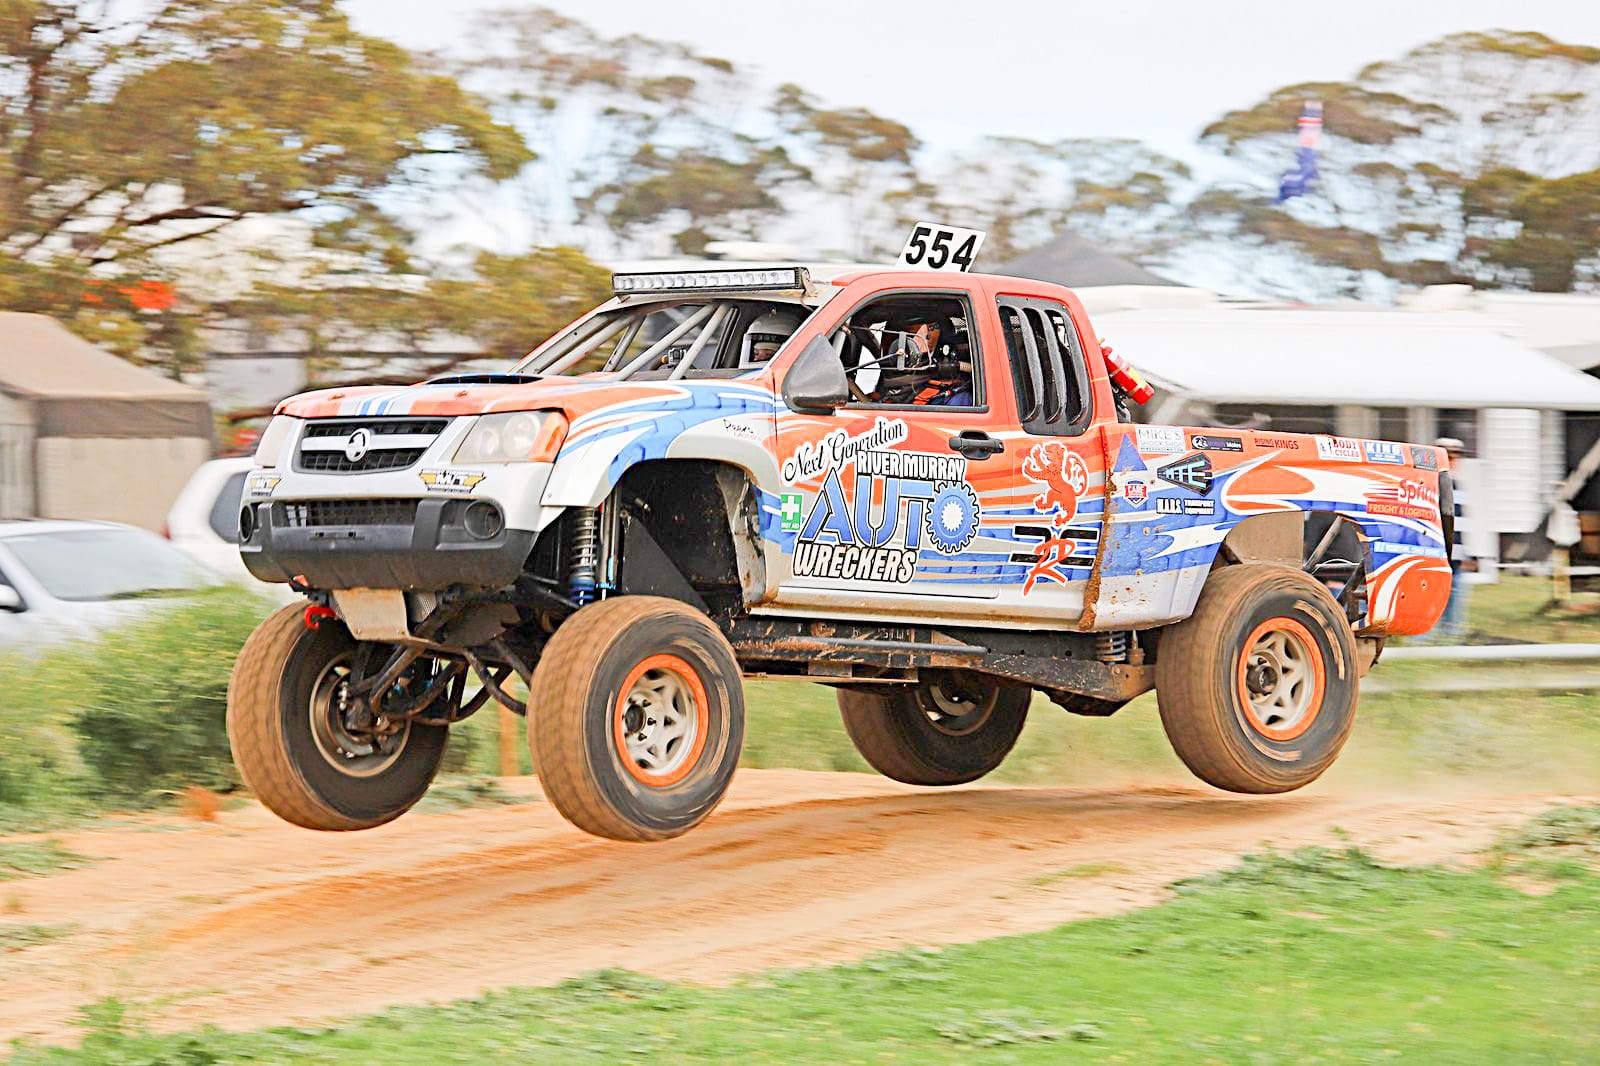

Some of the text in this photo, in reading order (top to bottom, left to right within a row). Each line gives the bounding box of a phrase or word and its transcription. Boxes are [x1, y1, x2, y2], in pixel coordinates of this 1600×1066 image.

[906, 227, 977, 272] 554
[784, 420, 903, 481] Next Generation
[1275, 440, 1299, 449] KINGS
[857, 451, 965, 481] RIVER MURRAY
[798, 467, 980, 553] AUTO
[1369, 504, 1398, 516] FREIGHT
[1405, 509, 1434, 520] LOGISTICS
[794, 543, 916, 583] WRECKERS
